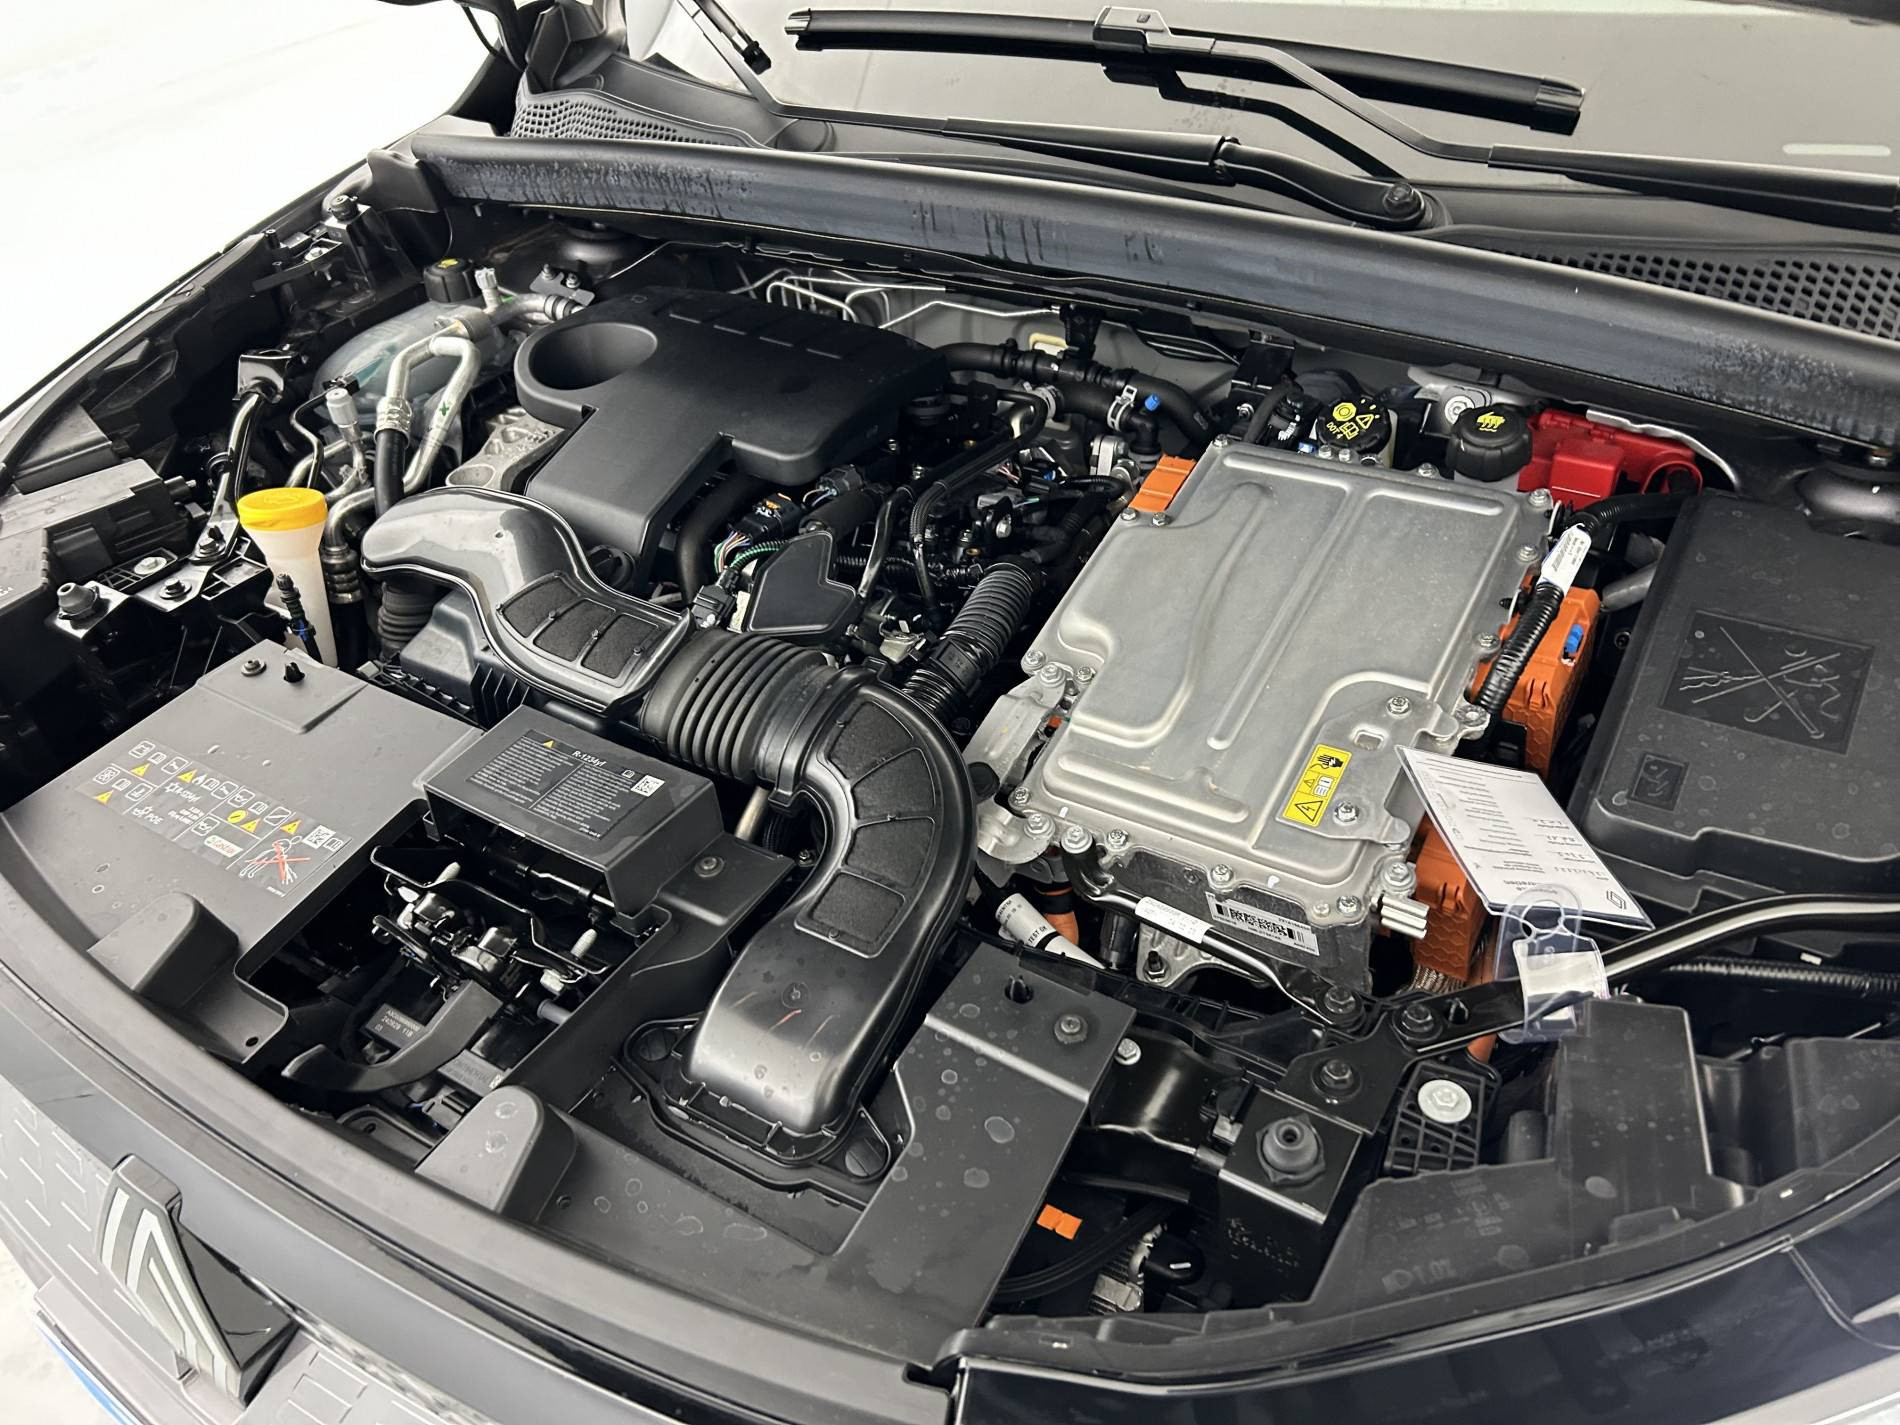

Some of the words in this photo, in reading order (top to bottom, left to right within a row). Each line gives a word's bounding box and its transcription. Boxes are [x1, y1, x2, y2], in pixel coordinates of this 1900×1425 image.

[1326, 421, 1341, 434] DOT
[571, 750, 607, 767] R-1234yf
[1027, 929, 1040, 944] TEST
